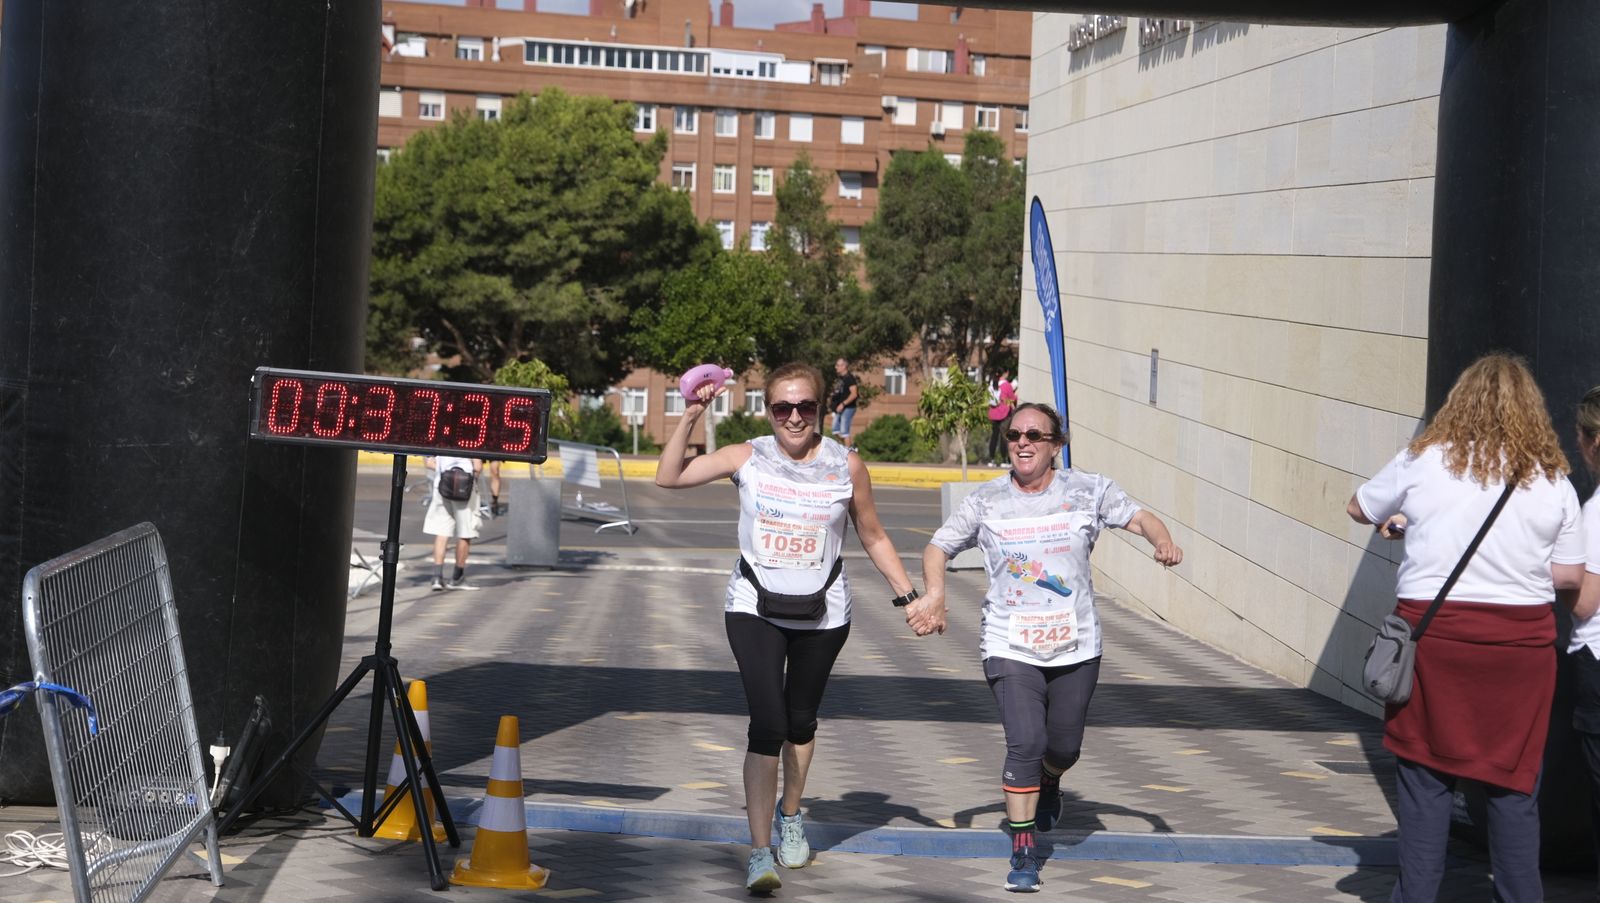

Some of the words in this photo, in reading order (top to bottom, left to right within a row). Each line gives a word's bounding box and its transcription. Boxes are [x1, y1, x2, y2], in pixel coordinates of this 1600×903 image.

[268, 379, 533, 451] 00:37:35
[761, 533, 817, 553] 1058
[1020, 626, 1071, 644] 1242
